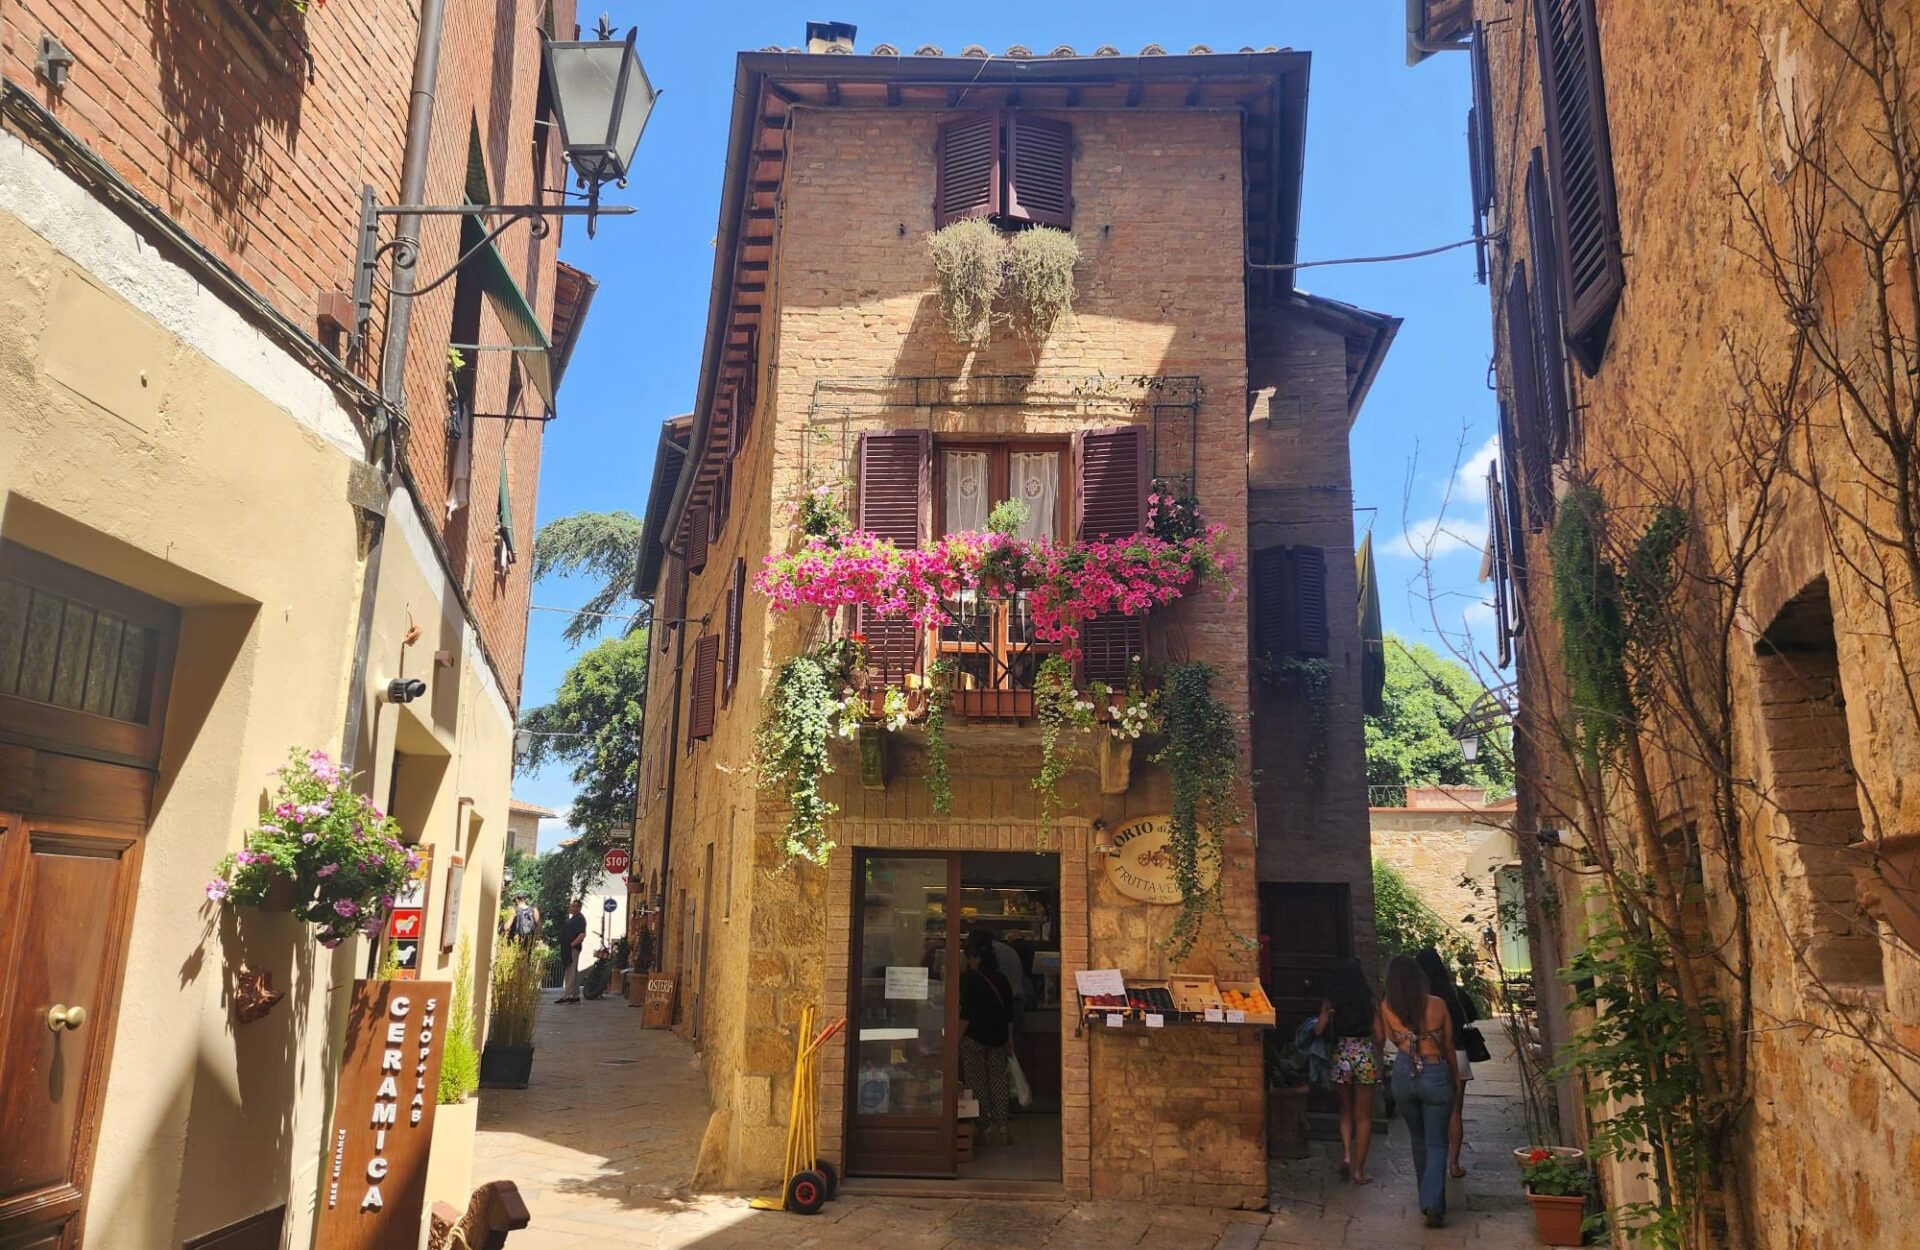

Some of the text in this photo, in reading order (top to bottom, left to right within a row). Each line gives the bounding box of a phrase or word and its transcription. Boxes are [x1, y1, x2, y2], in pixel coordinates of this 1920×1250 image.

[1109, 821, 1153, 859] LORTO
[606, 857, 628, 866] STOP
[648, 980, 673, 993] OSTERIA
[361, 997, 410, 1207] CERAMICA
[333, 1129, 347, 1177] ENTRANCE
